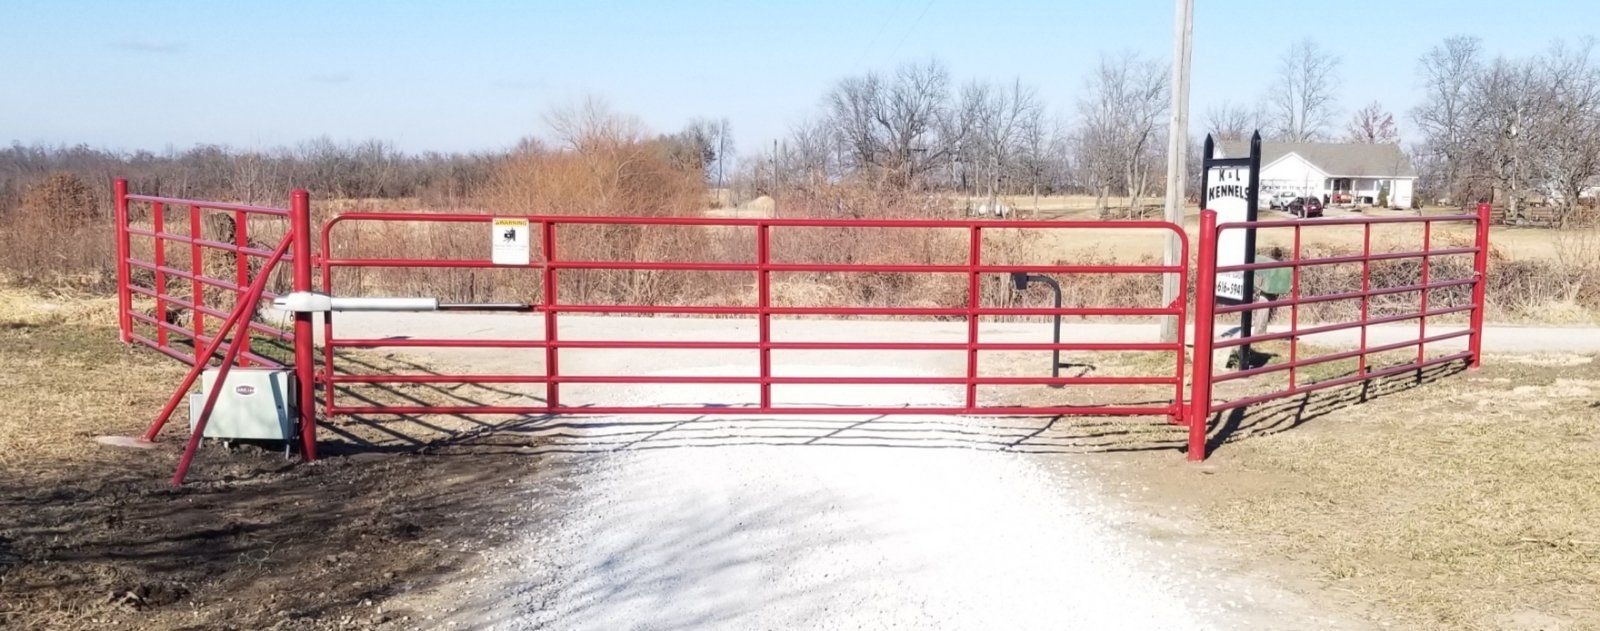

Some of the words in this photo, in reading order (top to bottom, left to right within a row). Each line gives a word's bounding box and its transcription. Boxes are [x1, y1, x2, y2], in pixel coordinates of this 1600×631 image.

[1219, 169, 1225, 181] K
[1236, 169, 1240, 181] L
[1209, 185, 1250, 201] KENNELS
